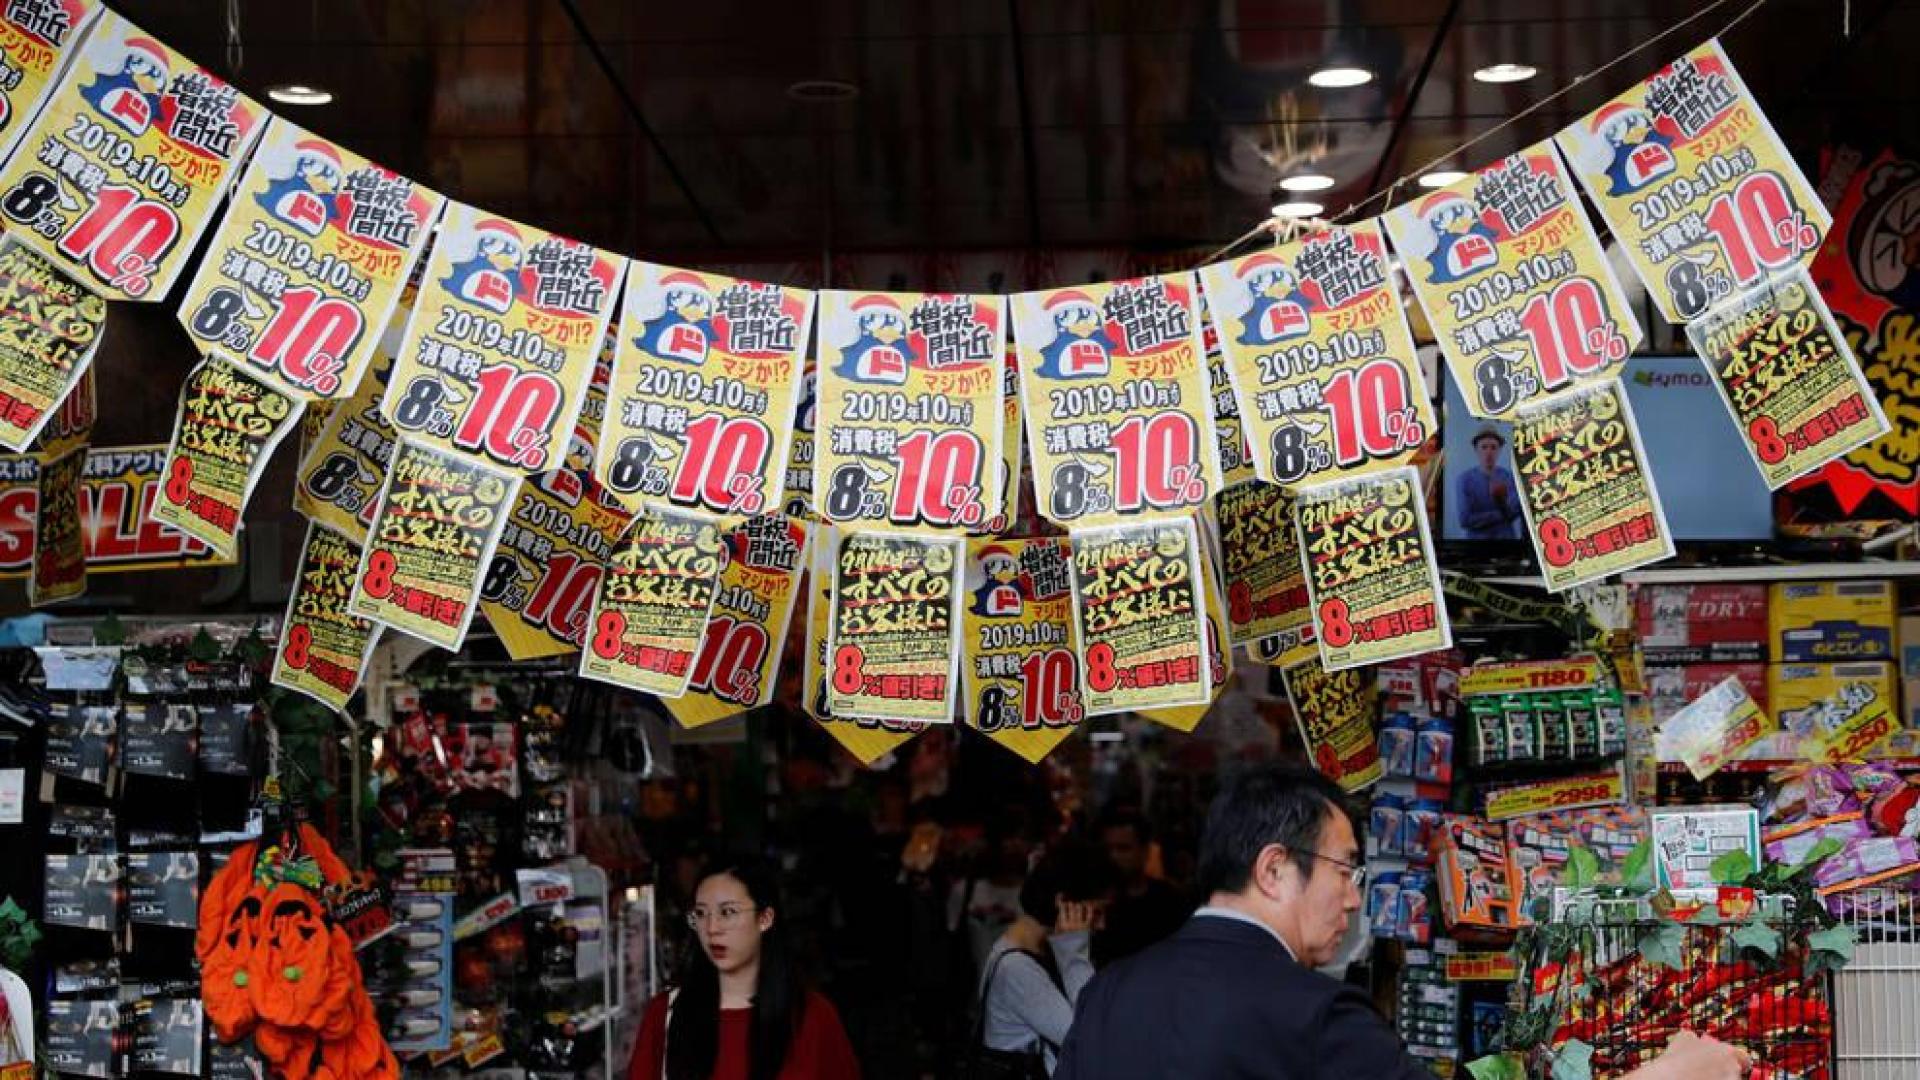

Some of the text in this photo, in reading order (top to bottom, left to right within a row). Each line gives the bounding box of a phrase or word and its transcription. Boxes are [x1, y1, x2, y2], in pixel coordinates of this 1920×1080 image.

[169, 72, 237, 119] 増税
[1645, 56, 1705, 116] 増税
[1674, 74, 1740, 139] 間近
[172, 108, 240, 158] 間近
[1690, 108, 1754, 157] マジか!?
[37, 133, 112, 197] 消費税
[158, 138, 222, 185] マジか!?
[1473, 153, 1537, 208] 増税
[1, 171, 66, 240] 8%
[344, 168, 411, 211] 増税
[1501, 174, 1567, 233] 間近
[57, 184, 182, 296] 10%
[348, 202, 417, 248] 間近
[1512, 210, 1578, 256] マジか!?
[1640, 212, 1708, 264] 消費税
[1702, 170, 1822, 288] 10%
[219, 248, 290, 300] 消費税
[335, 236, 402, 277] マジか!?
[527, 240, 594, 281] 増税
[1294, 229, 1358, 281] 増税
[1320, 253, 1386, 306] 間近
[538, 275, 602, 314] 間近
[716, 284, 783, 320] 増税
[910, 295, 975, 334] 増税
[1103, 277, 1168, 324] 増税
[1326, 290, 1393, 331] マジか!?
[1666, 261, 1732, 321] 8%
[191, 286, 255, 353] 8%
[249, 285, 366, 395] 10%
[525, 311, 594, 346] マジか!?
[731, 316, 795, 353] 間近
[1125, 304, 1191, 353] 間近
[1453, 306, 1521, 355] 消費税
[1519, 276, 1630, 392] 10%
[416, 332, 485, 385] 消費税
[721, 355, 790, 386] マジか!?
[928, 325, 994, 367] 間近
[1125, 347, 1195, 377] マジか!?
[394, 373, 455, 438] 8%
[923, 368, 992, 395] マジか!?
[1256, 379, 1323, 421] 消費税
[1474, 353, 1540, 414] 8%
[454, 361, 564, 471] 10%
[622, 396, 689, 437] 消費税
[1045, 420, 1111, 455] 消費税
[1321, 357, 1427, 469] 10%
[608, 436, 669, 496] 8%
[669, 411, 774, 515] 10%
[832, 424, 899, 459] 消費税
[1111, 409, 1208, 515] 10%
[1270, 424, 1333, 484] 8%
[826, 460, 887, 522] 8%
[890, 428, 985, 528] 10%
[1050, 460, 1113, 521] 8%
